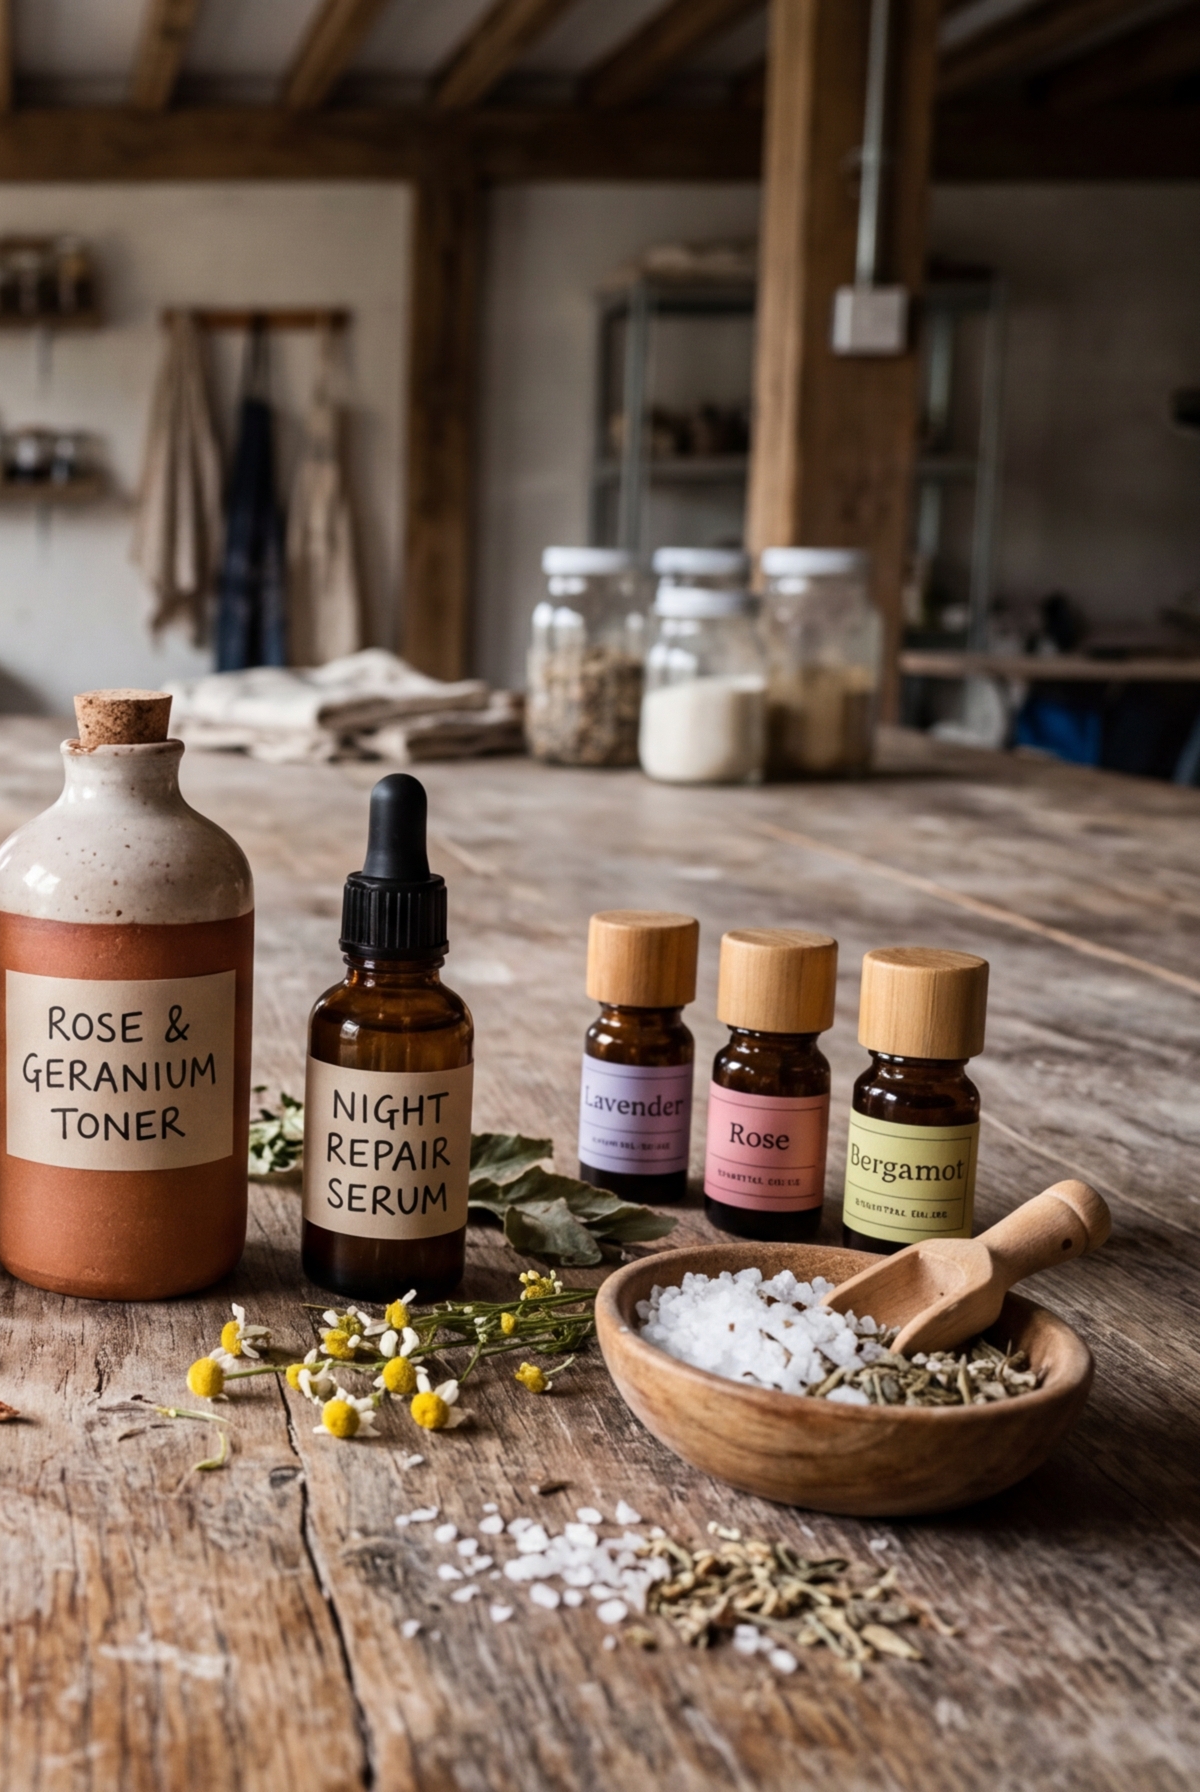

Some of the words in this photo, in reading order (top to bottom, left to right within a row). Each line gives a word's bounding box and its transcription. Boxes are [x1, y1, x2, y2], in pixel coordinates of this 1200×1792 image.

[48, 1005, 144, 1044] ROSE
[164, 1004, 191, 1043] &
[22, 1052, 217, 1094] GERANIUM
[333, 1088, 450, 1131] NIGHT
[585, 1085, 684, 1117] Lavender
[51, 1106, 186, 1142] TONER
[729, 1121, 790, 1151] Rose
[327, 1131, 451, 1172] REPAIR
[851, 1142, 965, 1183] Bergamot
[327, 1177, 448, 1216] SERUM
